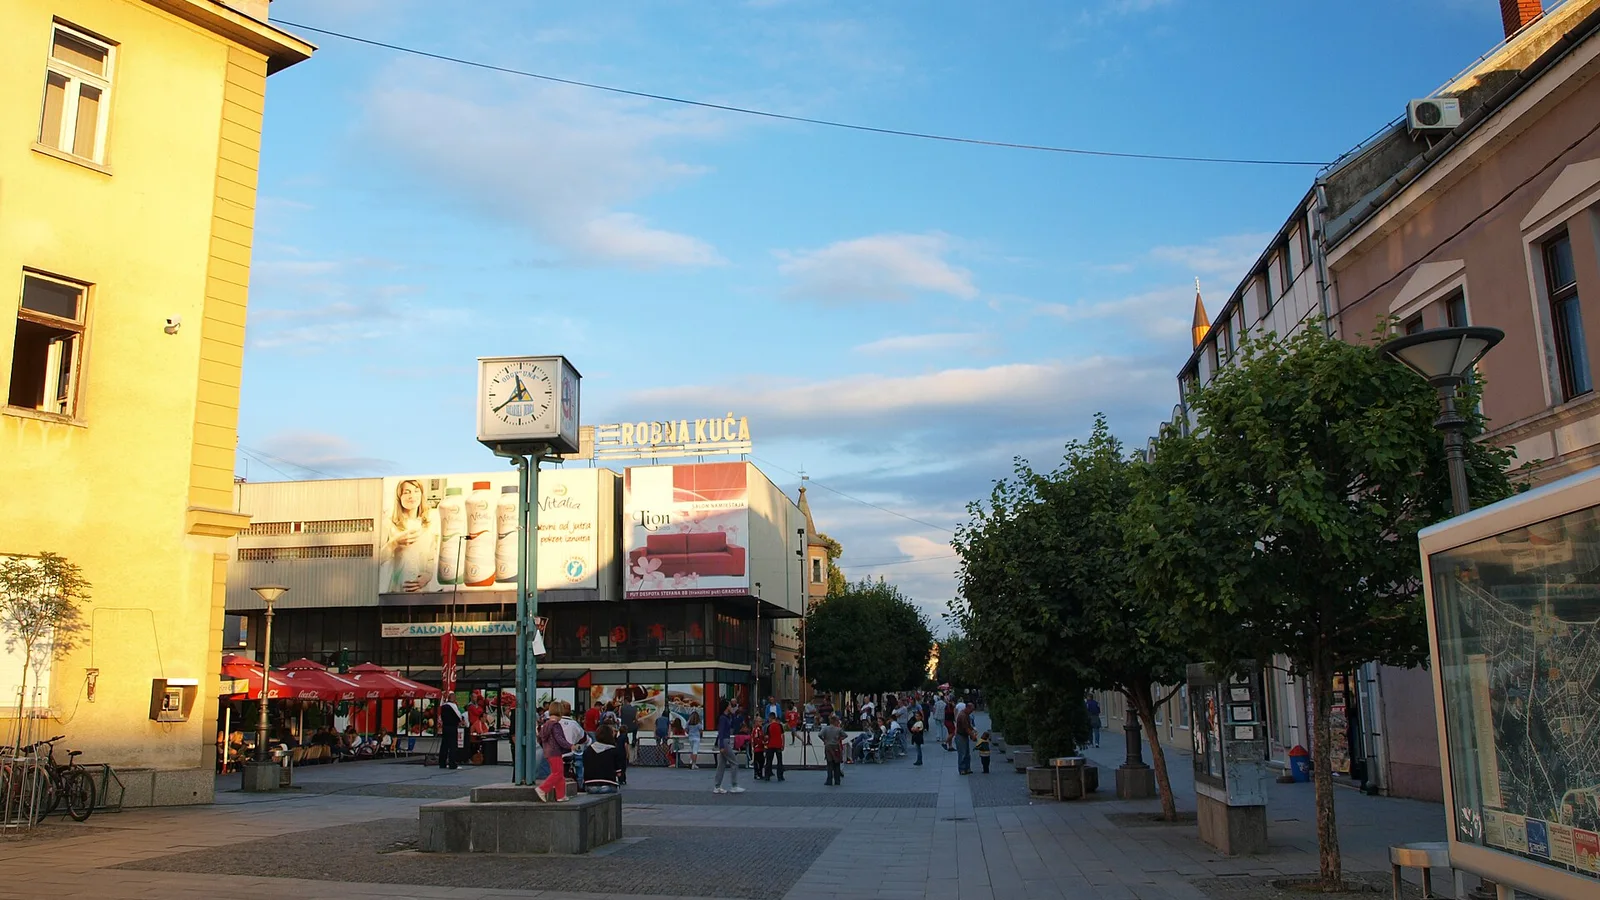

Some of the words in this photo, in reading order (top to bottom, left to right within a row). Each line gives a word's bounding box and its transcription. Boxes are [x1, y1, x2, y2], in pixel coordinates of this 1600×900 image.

[622, 420, 690, 446] ROBNA
[695, 411, 750, 443] KUĆA
[537, 496, 581, 511] Vitalia
[559, 520, 570, 530] od
[568, 522, 591, 534] jutra
[540, 534, 563, 547] pokret
[409, 625, 444, 634] SALON
[451, 623, 517, 634] NAMJEŠTAJ
